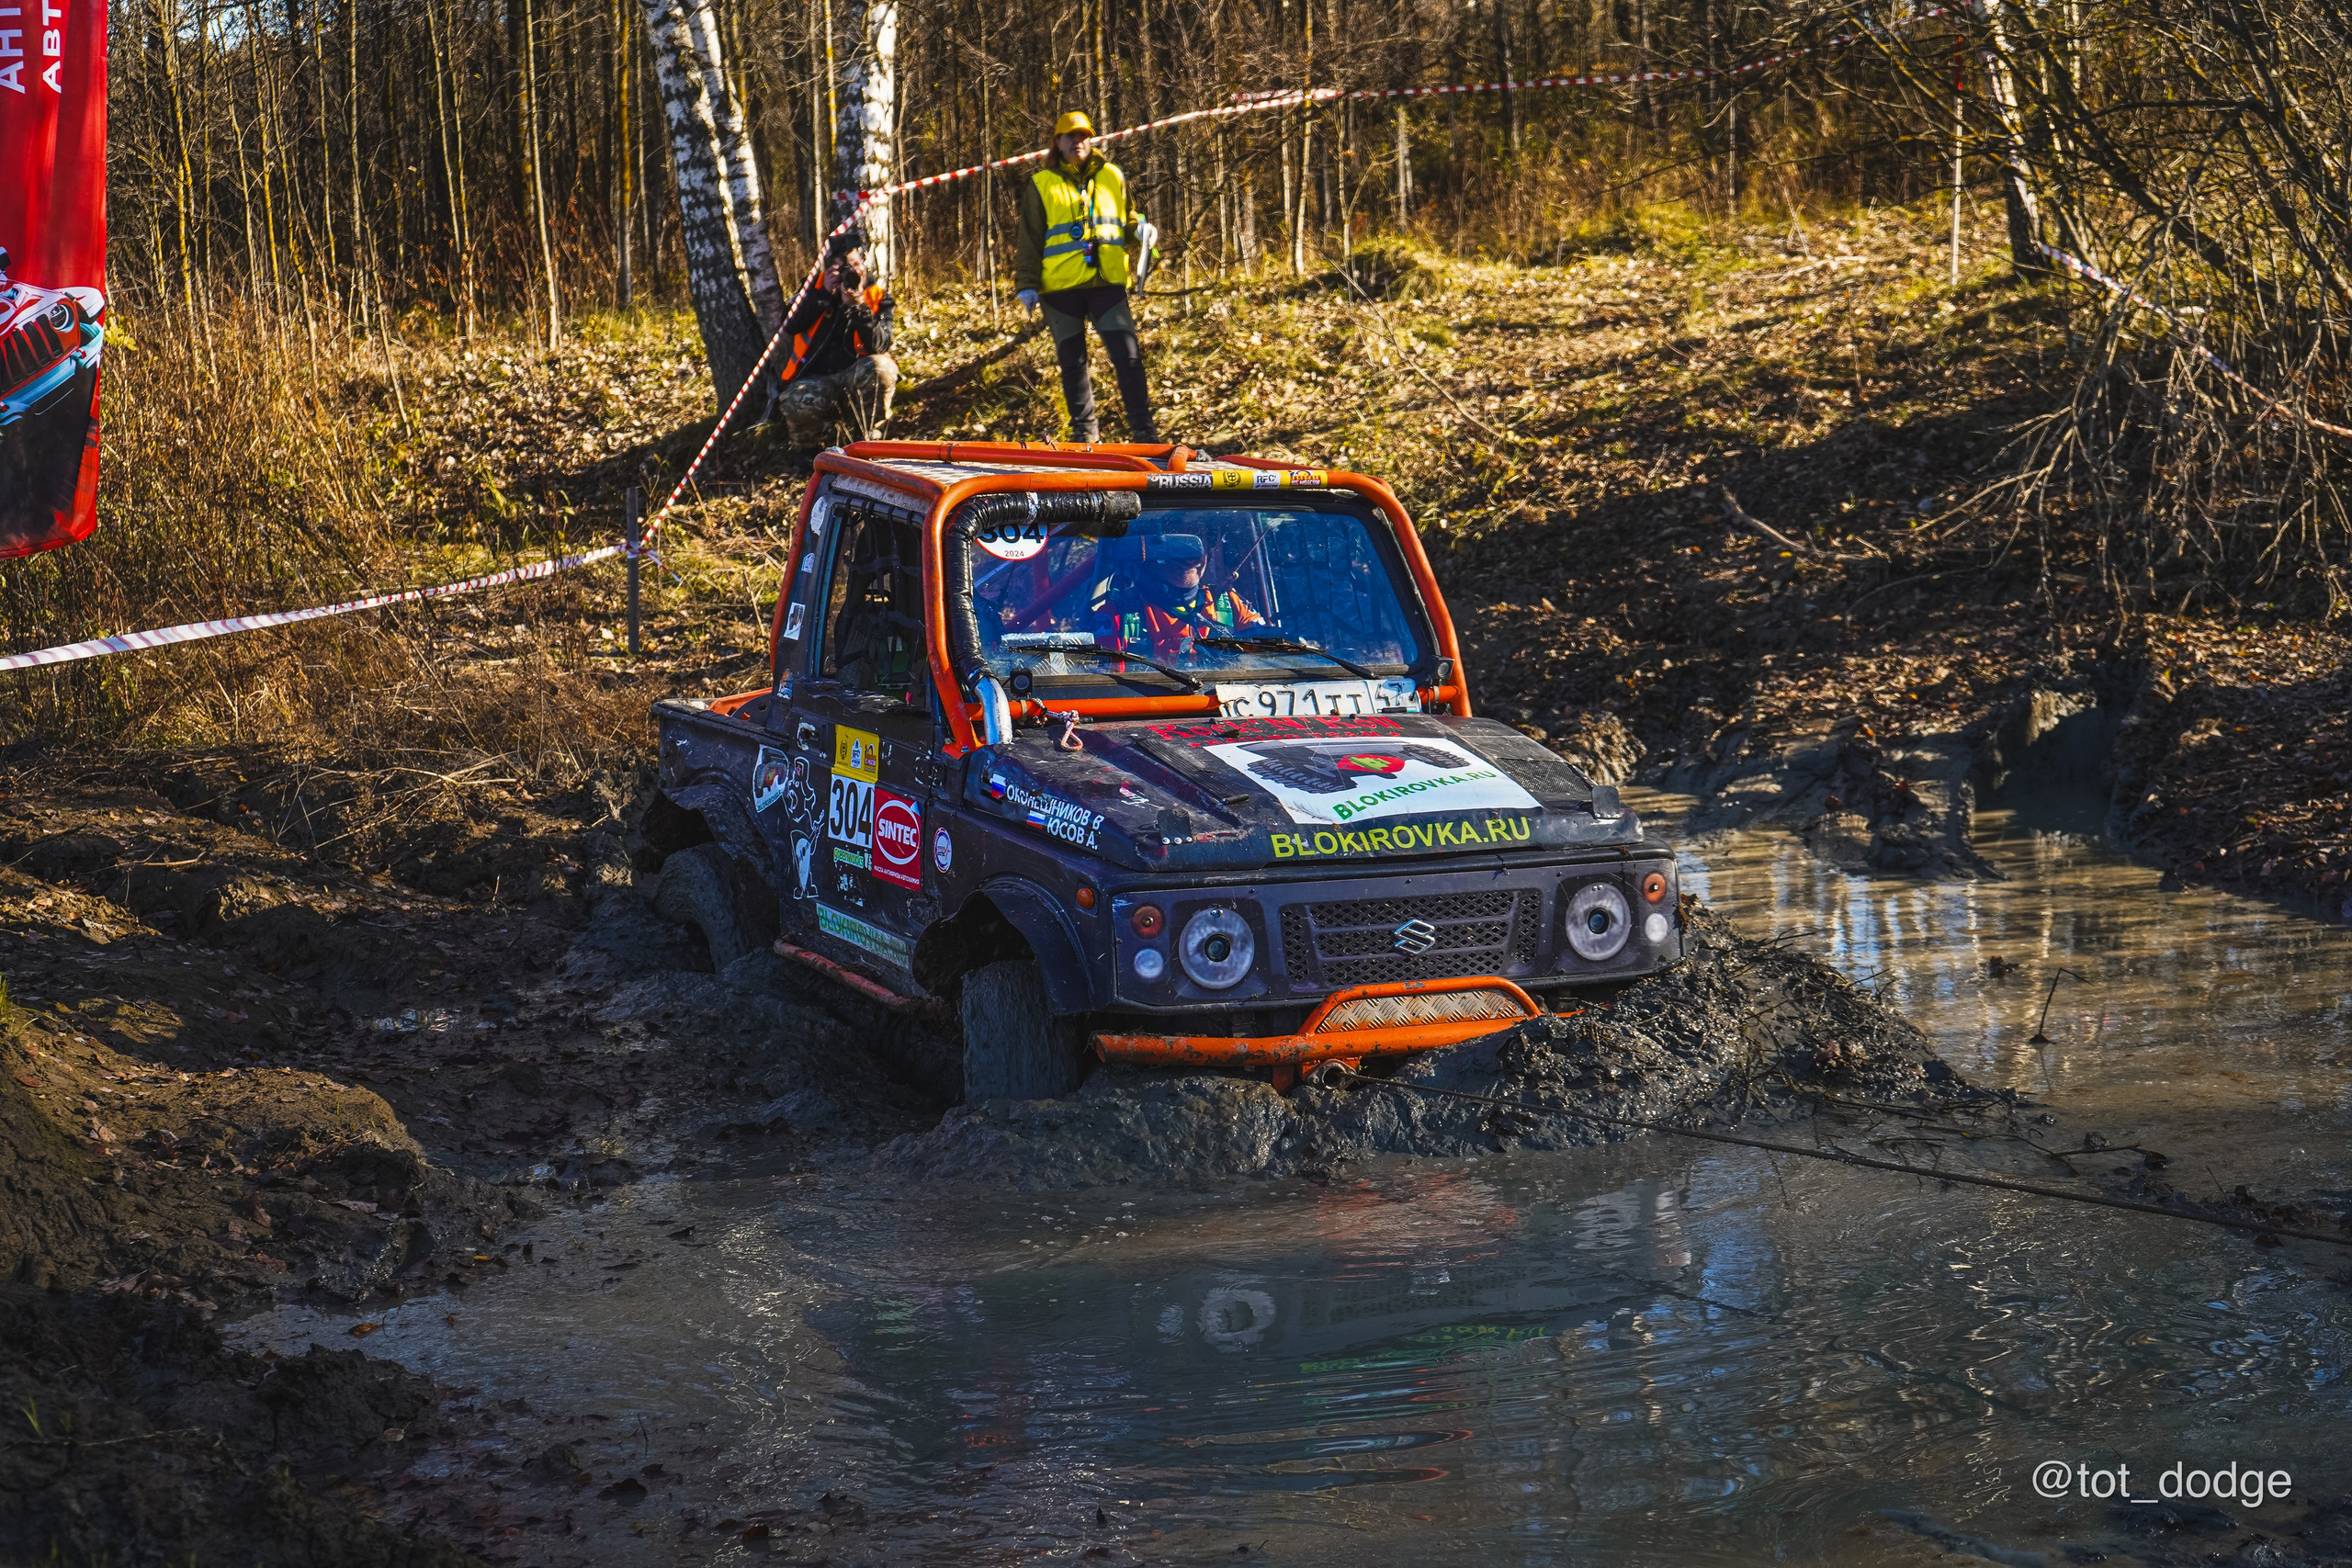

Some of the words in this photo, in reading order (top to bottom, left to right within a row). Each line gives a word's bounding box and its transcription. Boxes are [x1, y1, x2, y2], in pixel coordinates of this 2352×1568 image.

[42, 0, 62, 94] АВТ
[1159, 473, 1212, 489] RUSSIA
[977, 520, 1044, 544] 304
[1332, 770, 1498, 820] BLOKIROVKA.RU
[830, 778, 873, 846] 304
[877, 818, 917, 848] SINTEC
[1046, 817, 1084, 844] ЮСОВ
[1271, 816, 1532, 858] BLOKIROVKA.RU
[833, 847, 864, 869] greenworks
